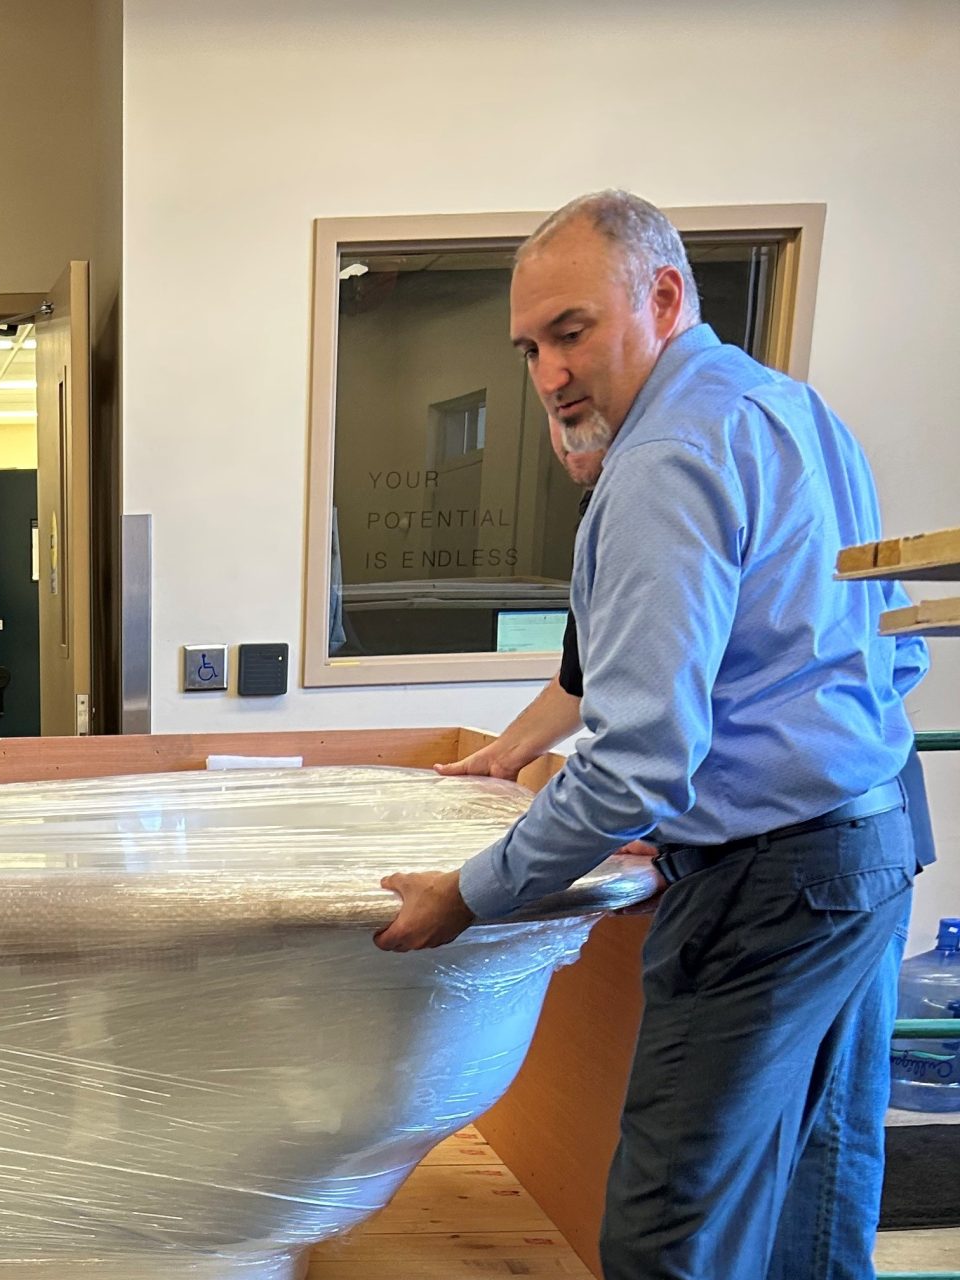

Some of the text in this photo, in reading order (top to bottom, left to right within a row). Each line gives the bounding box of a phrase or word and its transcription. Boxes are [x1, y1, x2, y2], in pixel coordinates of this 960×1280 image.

[368, 470, 440, 489] YOUR
[367, 508, 511, 530] POTENTIAL
[365, 551, 388, 570] IS
[891, 1050, 953, 1078] Culliga
